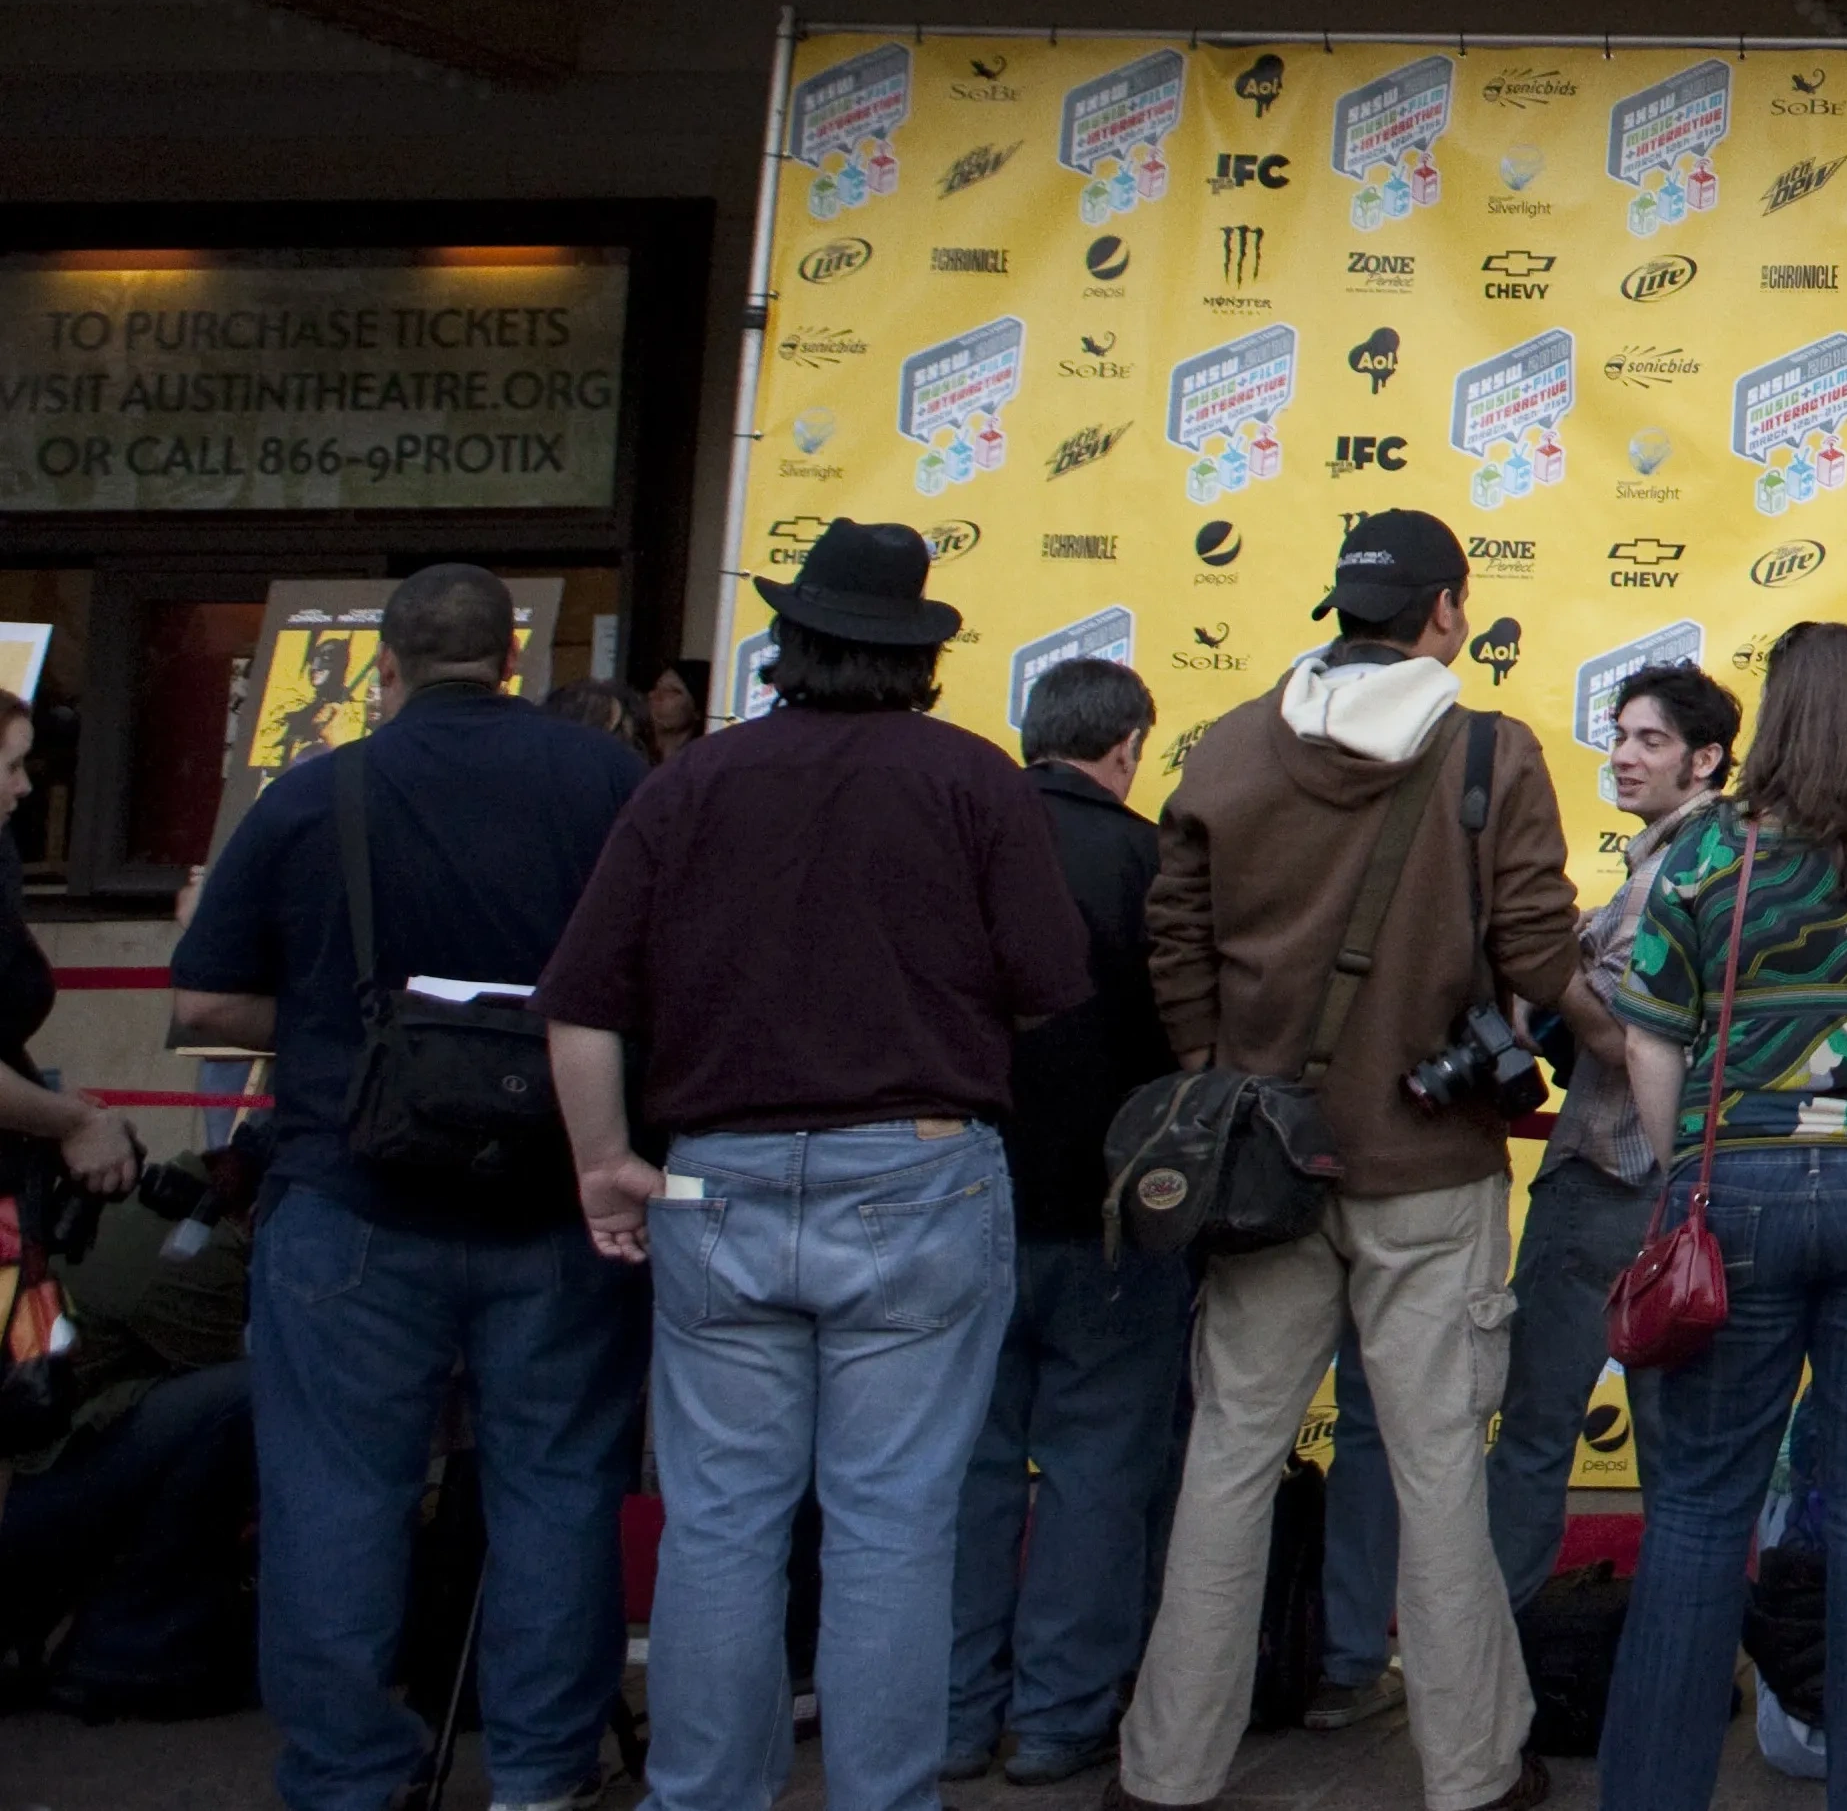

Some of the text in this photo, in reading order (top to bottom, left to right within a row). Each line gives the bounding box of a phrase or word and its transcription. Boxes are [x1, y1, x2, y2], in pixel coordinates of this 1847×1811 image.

[1217, 153, 1290, 189] IFC
[1487, 201, 1551, 219] Silverlight
[1635, 267, 1686, 299] Lite
[1769, 265, 1838, 289] CHRONICLE
[1485, 283, 1549, 299] CHEVY
[46, 307, 570, 349] TO PURCHASE TICKETS
[1628, 358, 1700, 374] sonicbids
[120, 370, 612, 412] AUSTINTHEATRE.ORG
[37, 436, 111, 477] OR
[126, 435, 245, 475] CALL
[1336, 436, 1408, 471] IFC
[1616, 486, 1681, 504] Silverlight
[1610, 571, 1679, 588] CHEVY
[1765, 552, 1815, 584] Lite
[1599, 832, 1629, 853] ZO
[1582, 1459, 1628, 1474] pepsi
